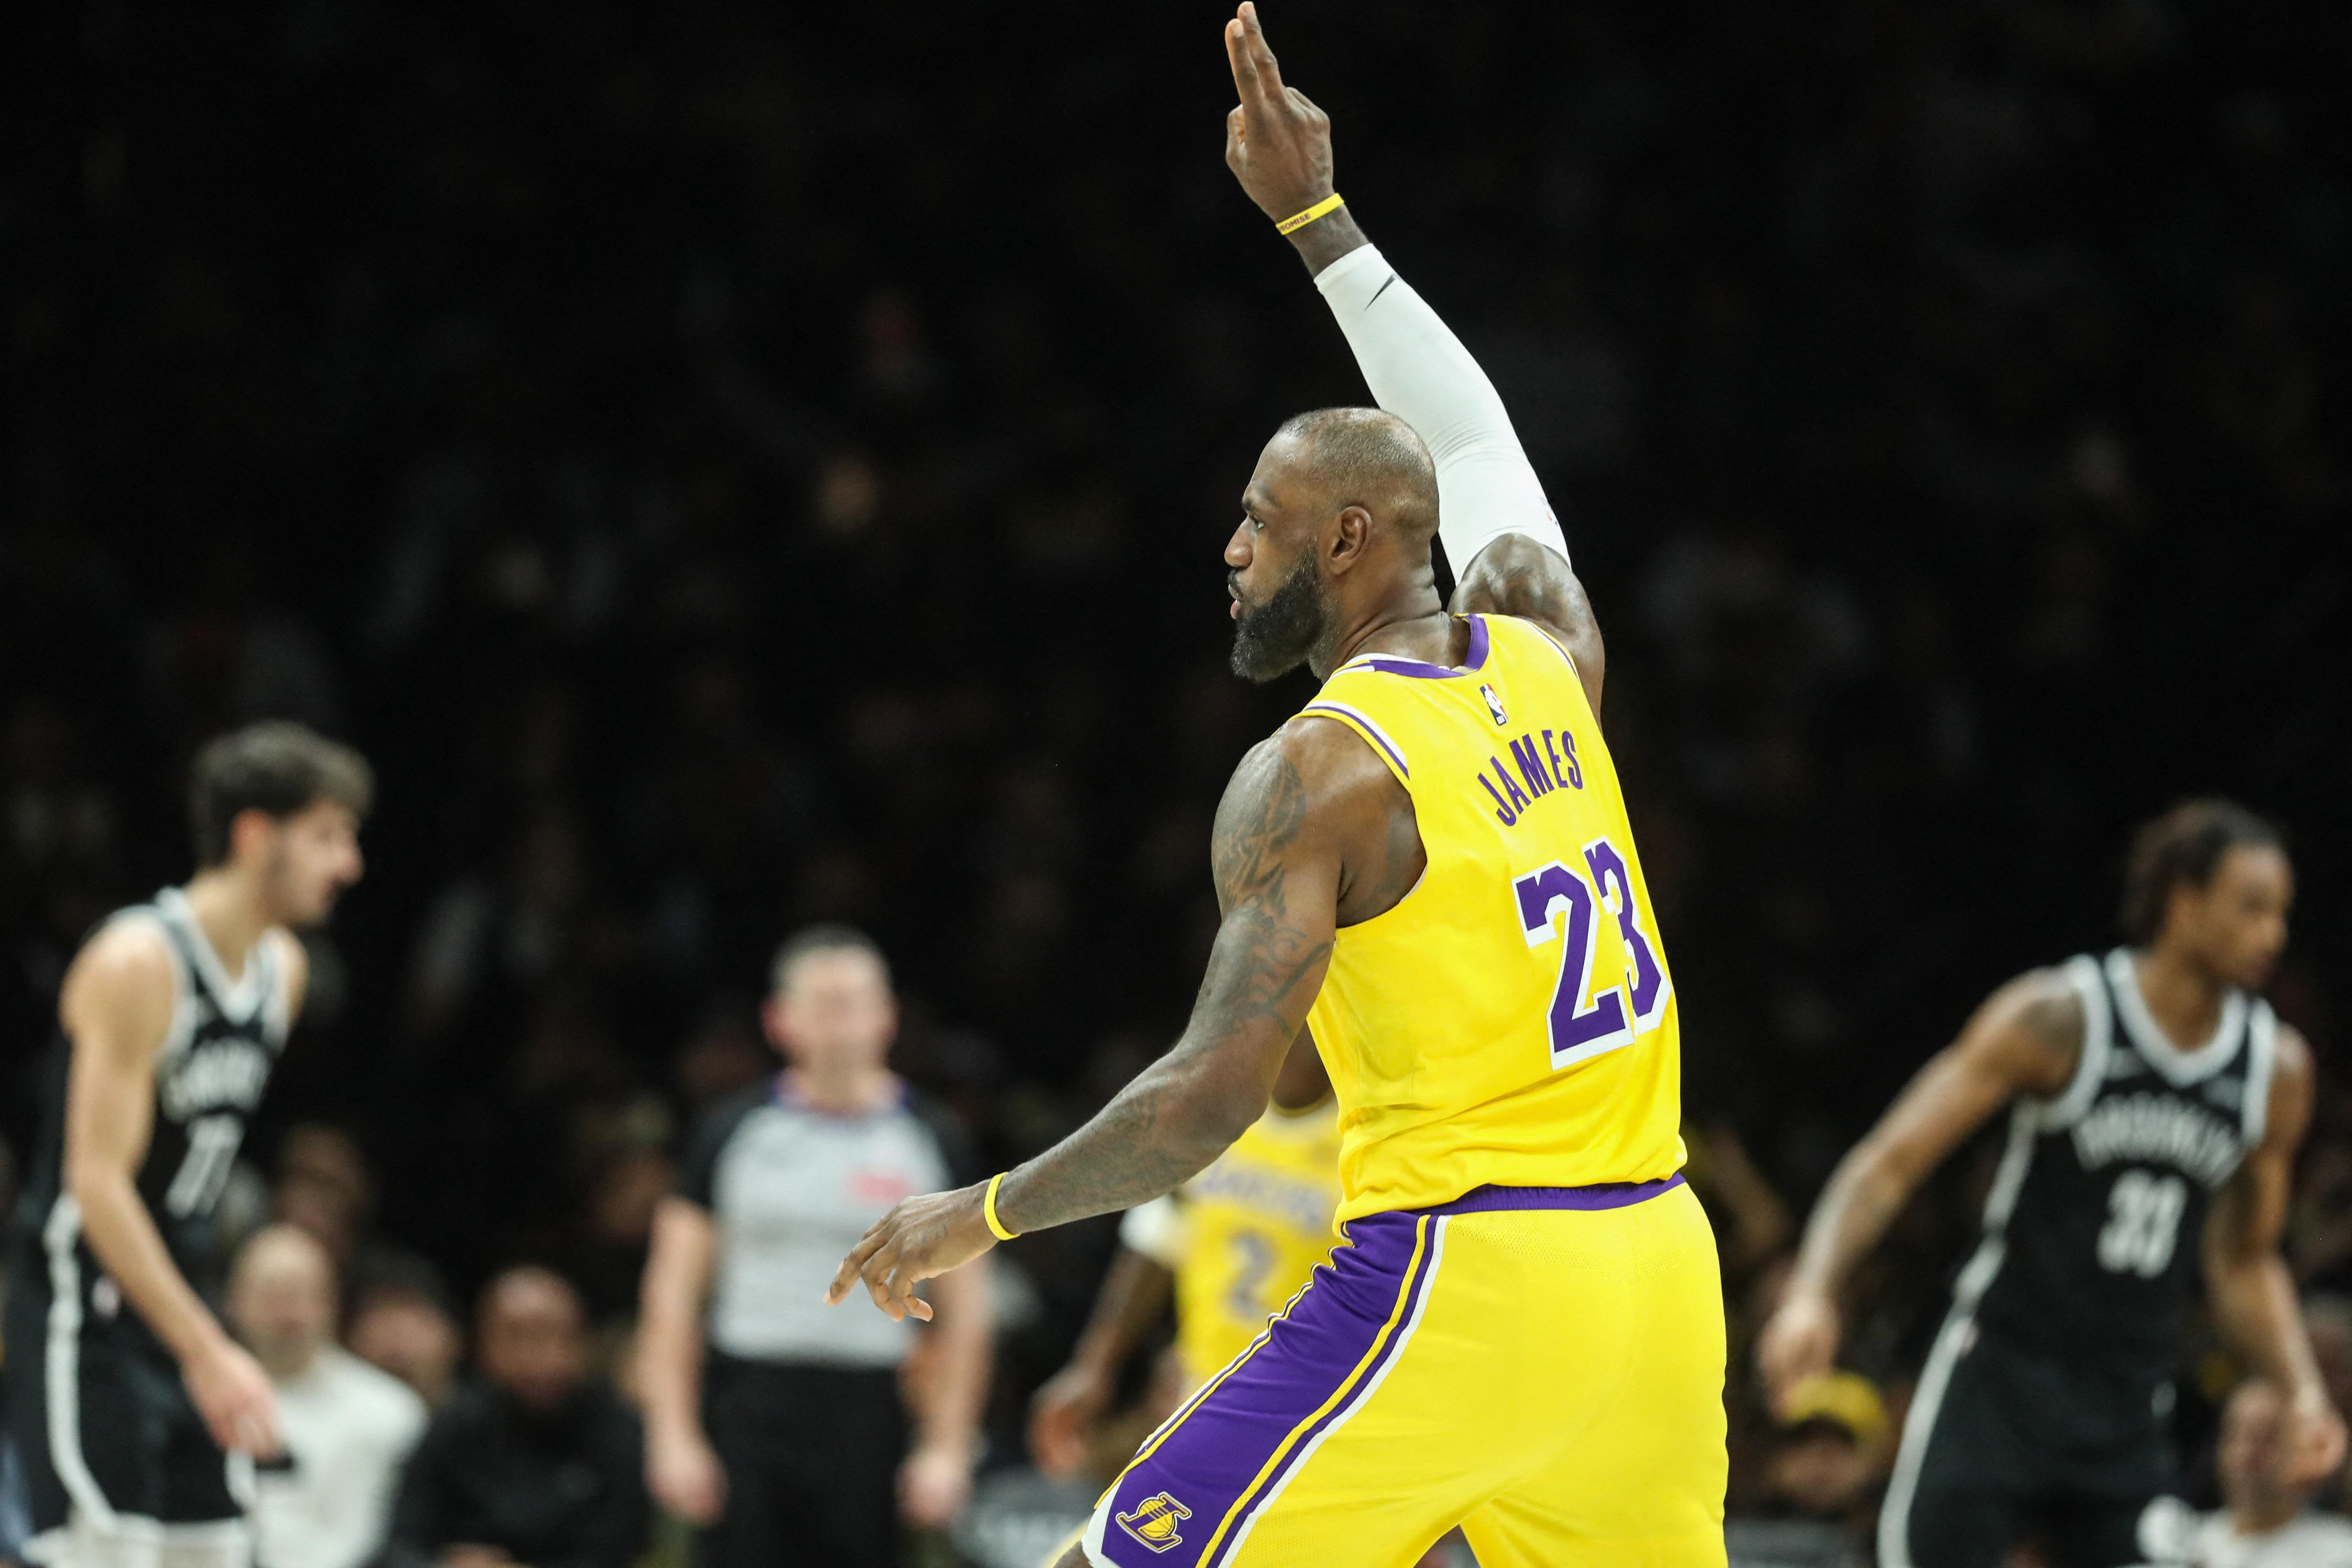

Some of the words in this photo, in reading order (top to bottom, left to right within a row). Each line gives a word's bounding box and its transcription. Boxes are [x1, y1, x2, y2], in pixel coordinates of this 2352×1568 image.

[1280, 214, 1311, 231] ROMISE
[1477, 729, 1583, 827] JAMES
[1511, 835, 1672, 1071] 23
